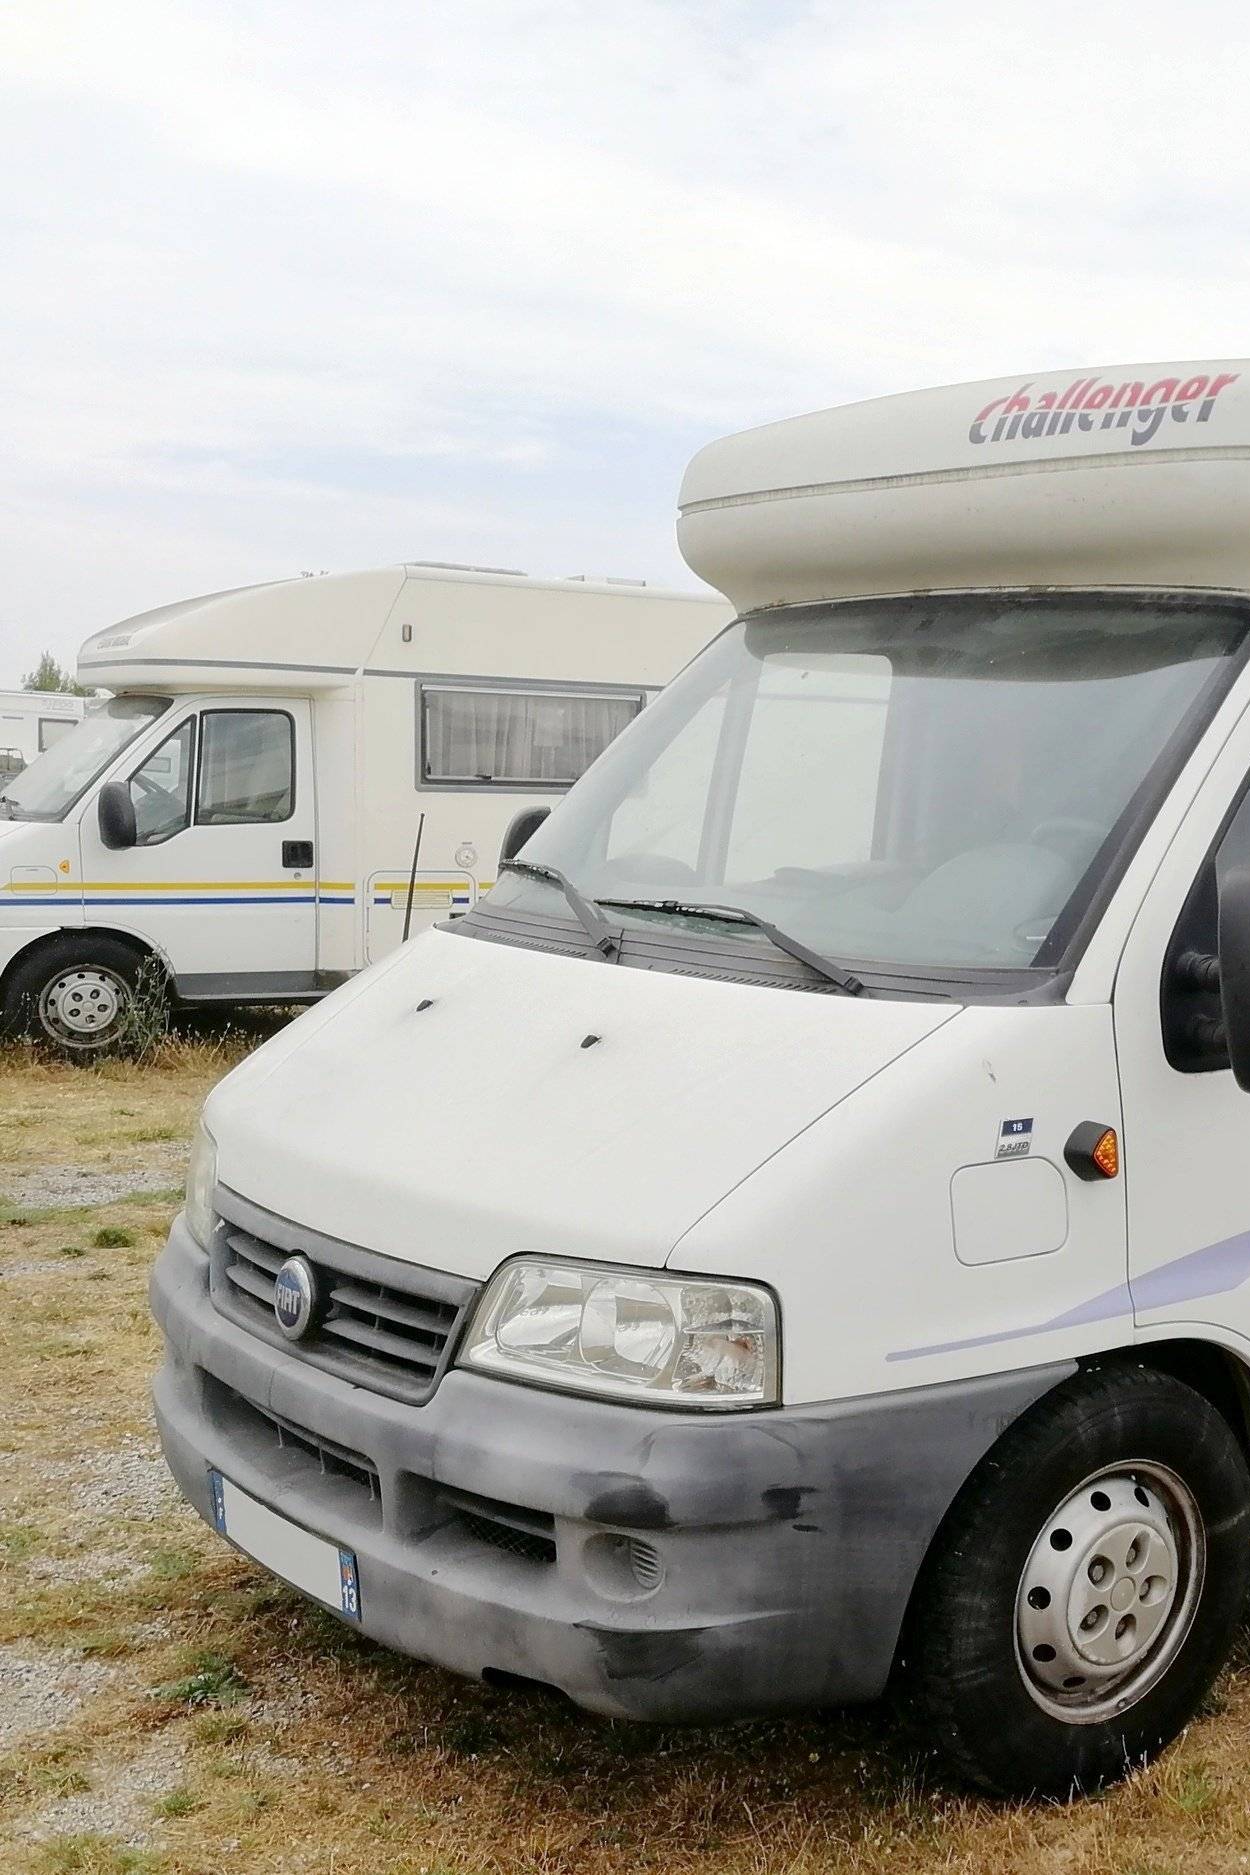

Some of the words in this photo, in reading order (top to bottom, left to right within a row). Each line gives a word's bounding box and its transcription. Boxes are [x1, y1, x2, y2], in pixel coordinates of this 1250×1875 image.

[968, 373, 1242, 446] Challenger
[277, 1283, 300, 1315] FIAT
[342, 1585, 357, 1613] 13
